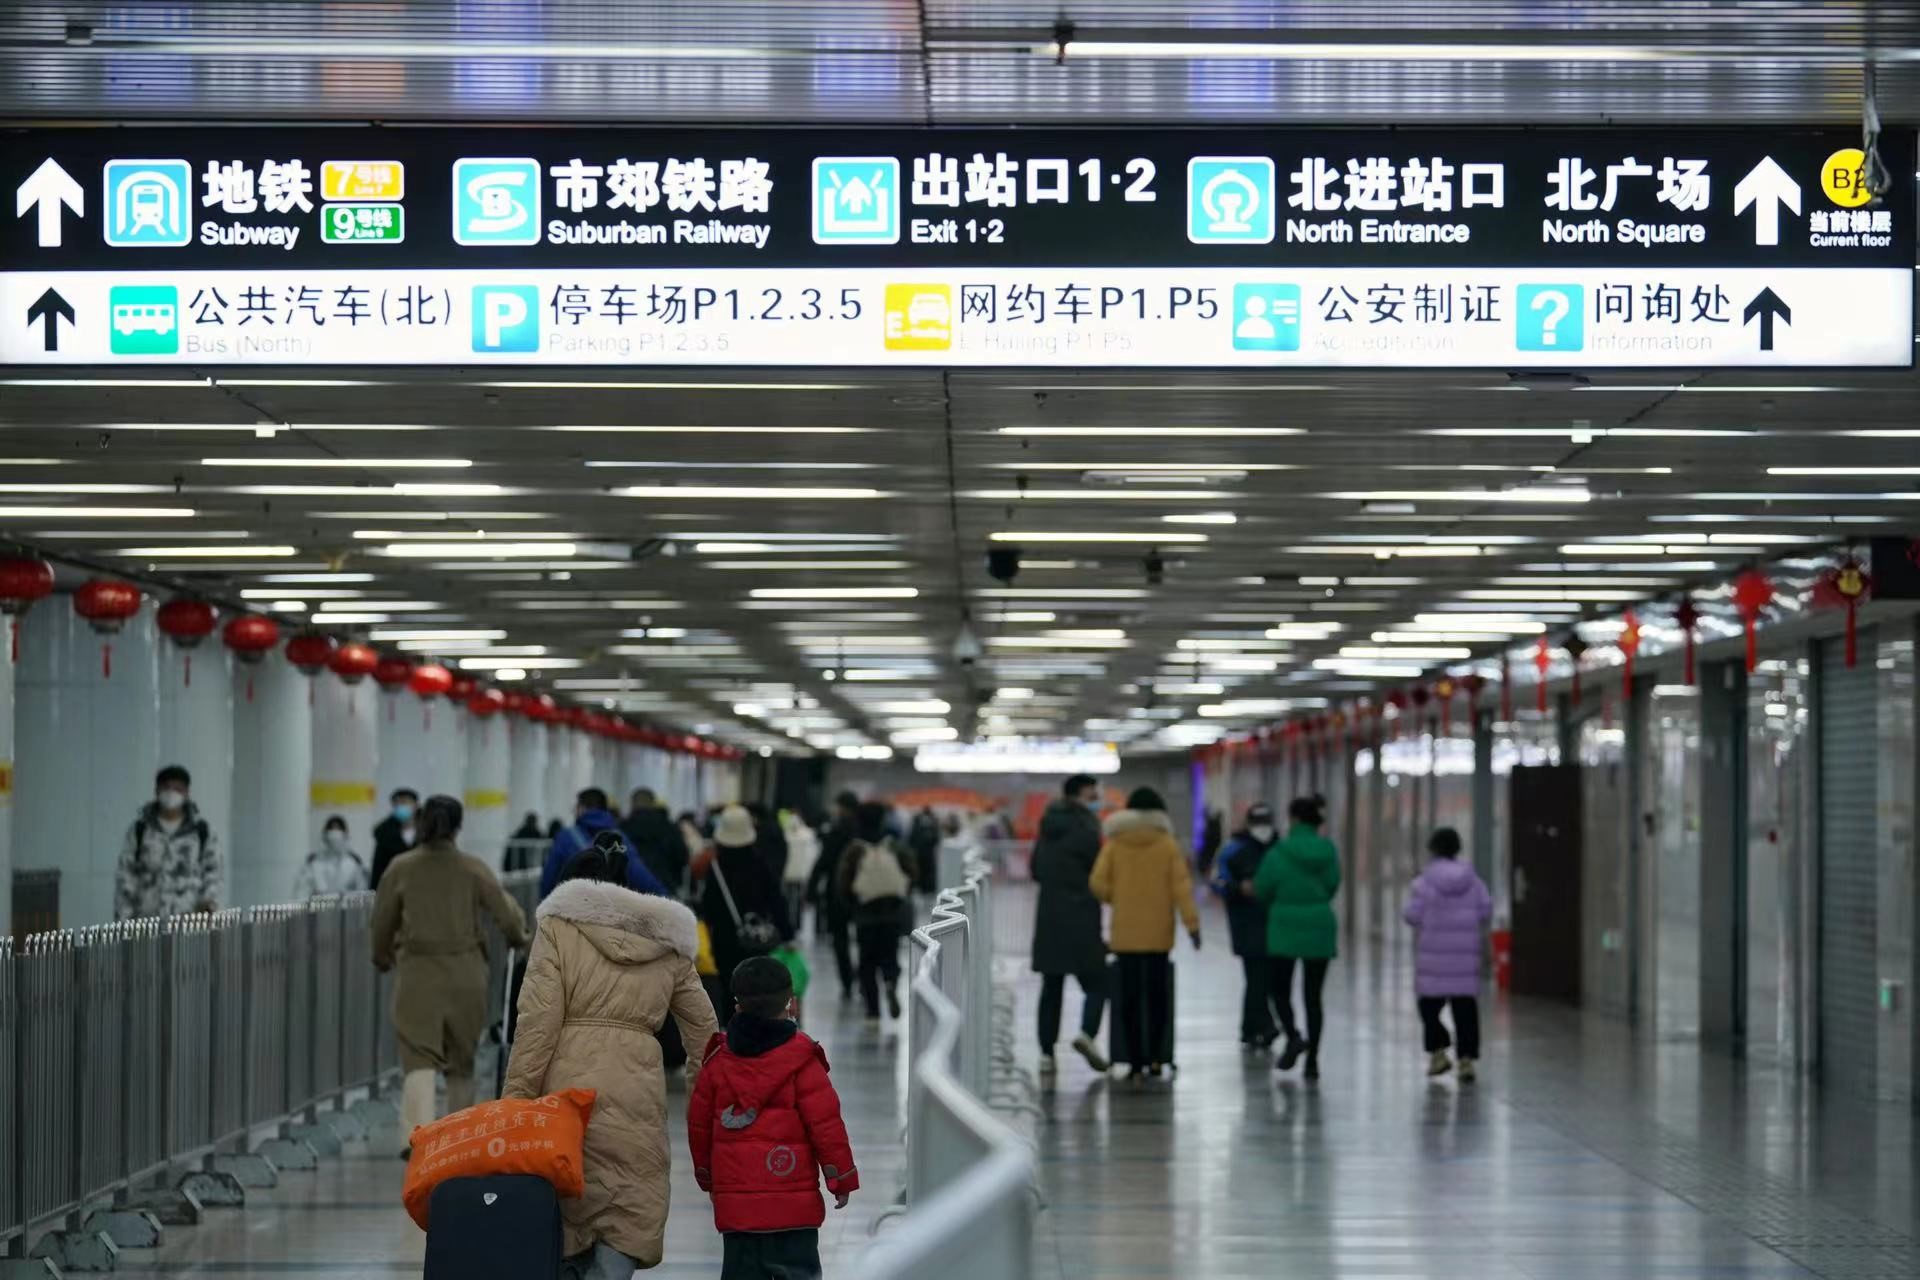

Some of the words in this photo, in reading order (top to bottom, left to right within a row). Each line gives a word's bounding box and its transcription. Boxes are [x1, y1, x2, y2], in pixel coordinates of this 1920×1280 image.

[202, 159, 313, 213] 地铁
[333, 164, 392, 195] 7号线
[550, 158, 773, 212] 市郊铁路
[1288, 157, 1503, 211] 北进站口
[1544, 157, 1710, 211] 北广场
[201, 222, 299, 250] Subway
[333, 208, 392, 239] 9号线
[548, 220, 666, 244] Suburban
[674, 220, 771, 248] Railway
[912, 219, 958, 242] Exit
[1287, 219, 1352, 242] North
[1361, 219, 1469, 242] Entrance
[1543, 220, 1609, 242] North
[1617, 219, 1705, 247] Square
[1810, 210, 1892, 233] 当前楼层
[1810, 234, 1858, 247] Current
[1862, 234, 1892, 247] floor
[189, 286, 450, 326] 公共汽车(北)
[551, 285, 861, 325] 停车场P1.2.3.5
[961, 284, 1217, 323] 网约车P1.P5
[1319, 284, 1500, 323] 公安制证
[1597, 283, 1729, 323] 问询处
[187, 335, 228, 353] Bus
[236, 335, 311, 357] (North)
[549, 333, 631, 356] Parking
[1592, 333, 1712, 352] Information
